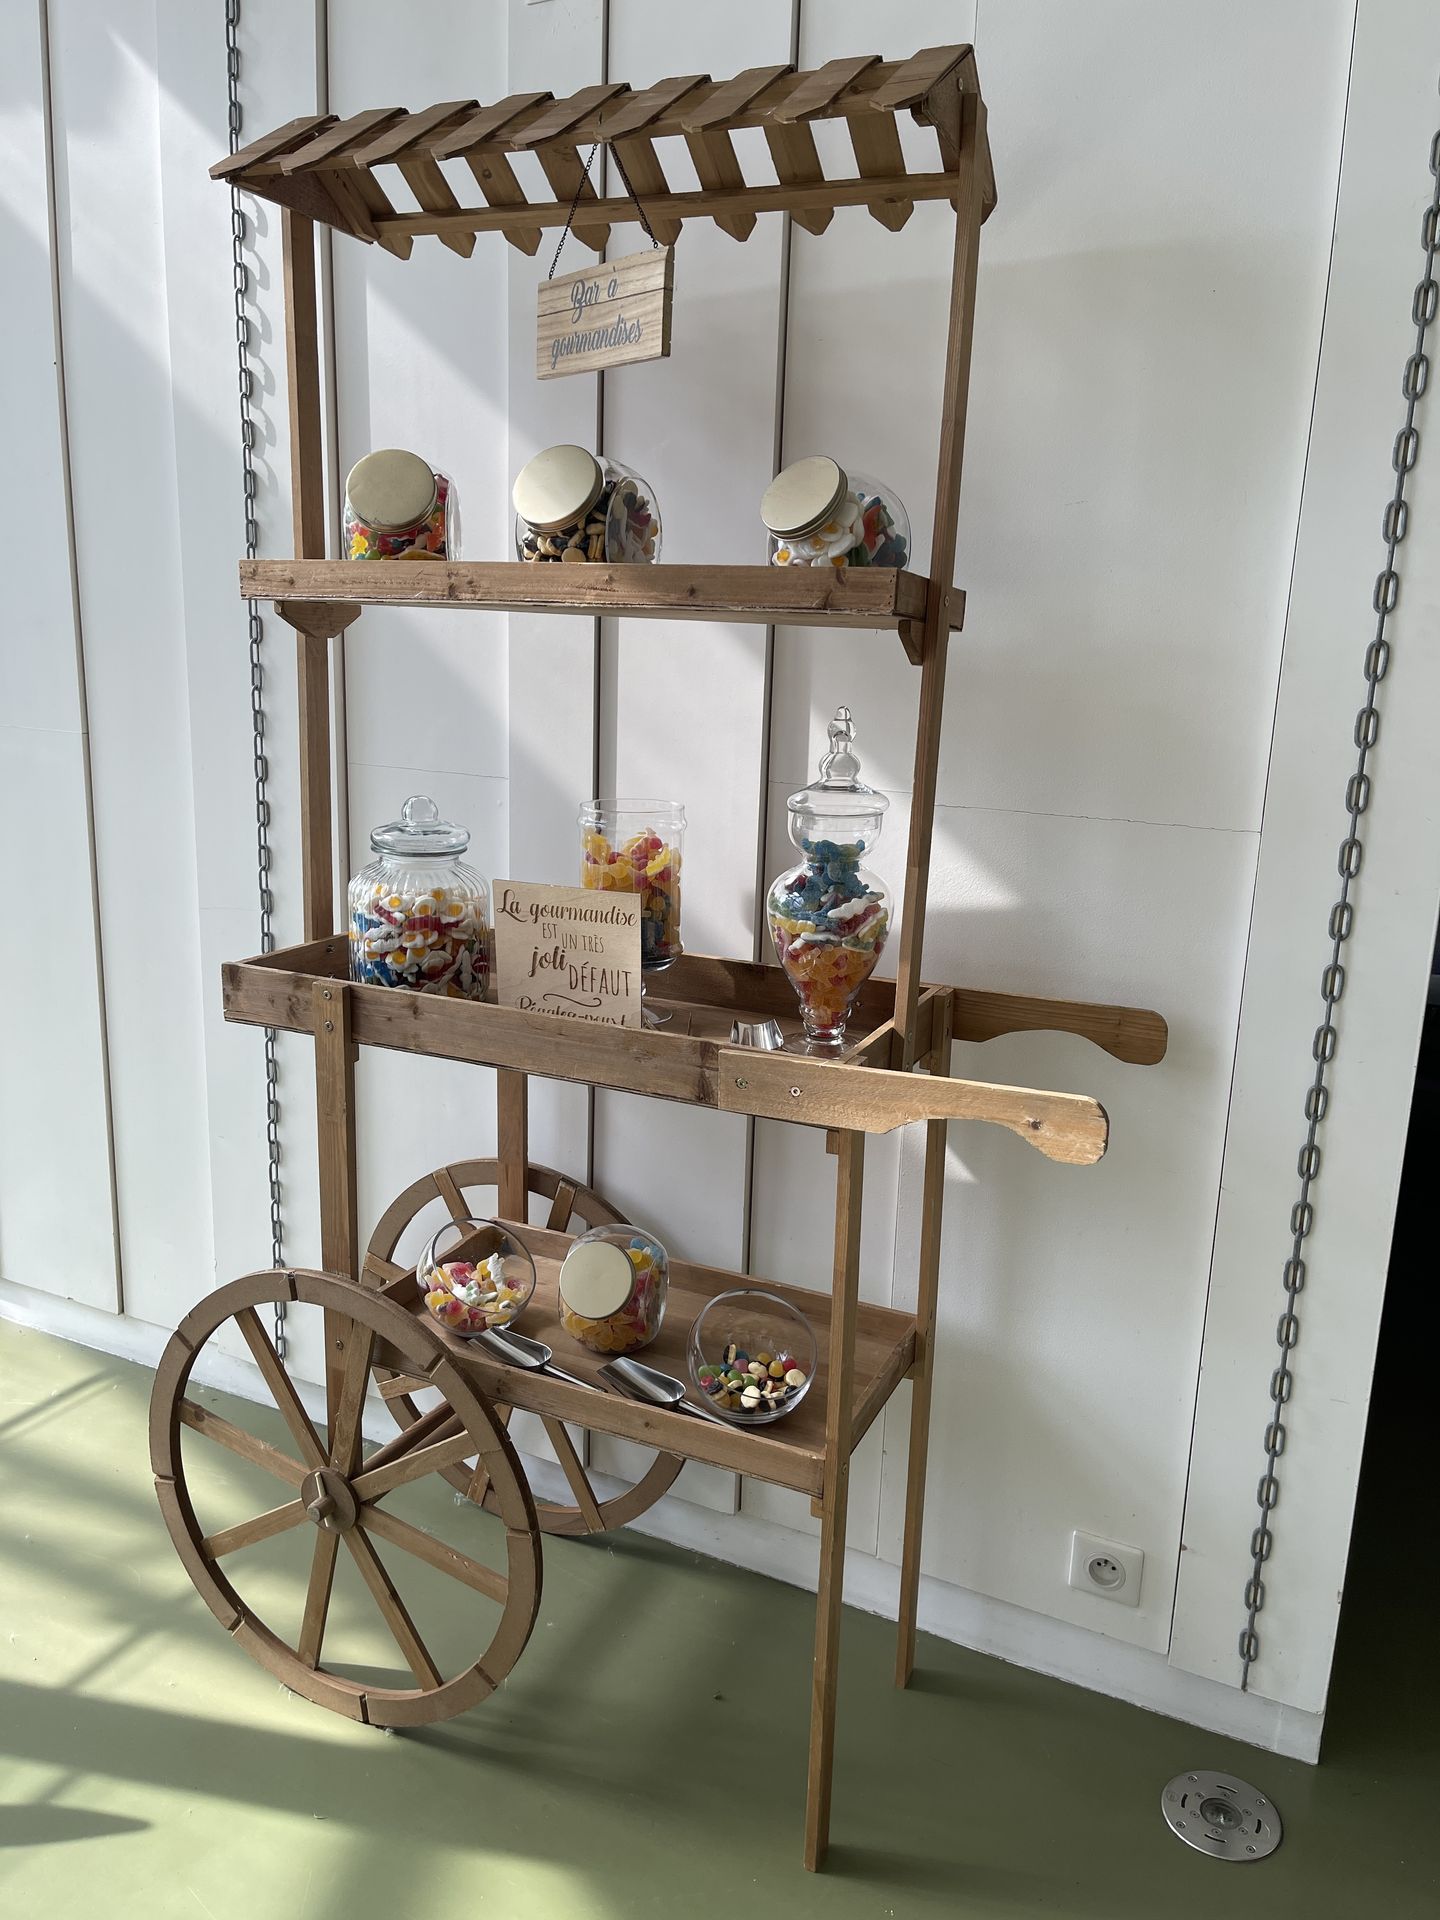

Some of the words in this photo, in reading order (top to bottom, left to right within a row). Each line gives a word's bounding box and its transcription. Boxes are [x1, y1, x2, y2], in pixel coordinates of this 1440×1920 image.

[570, 278, 600, 324] Bar
[550, 313, 644, 370] gourmandises
[496, 888, 528, 923] La
[529, 902, 638, 927] gourmandise
[542, 922, 558, 939] EST
[561, 933, 578, 950] UN
[582, 934, 604, 953] TRÈS
[527, 945, 569, 978] joli
[569, 961, 632, 997] DÉFAUT
